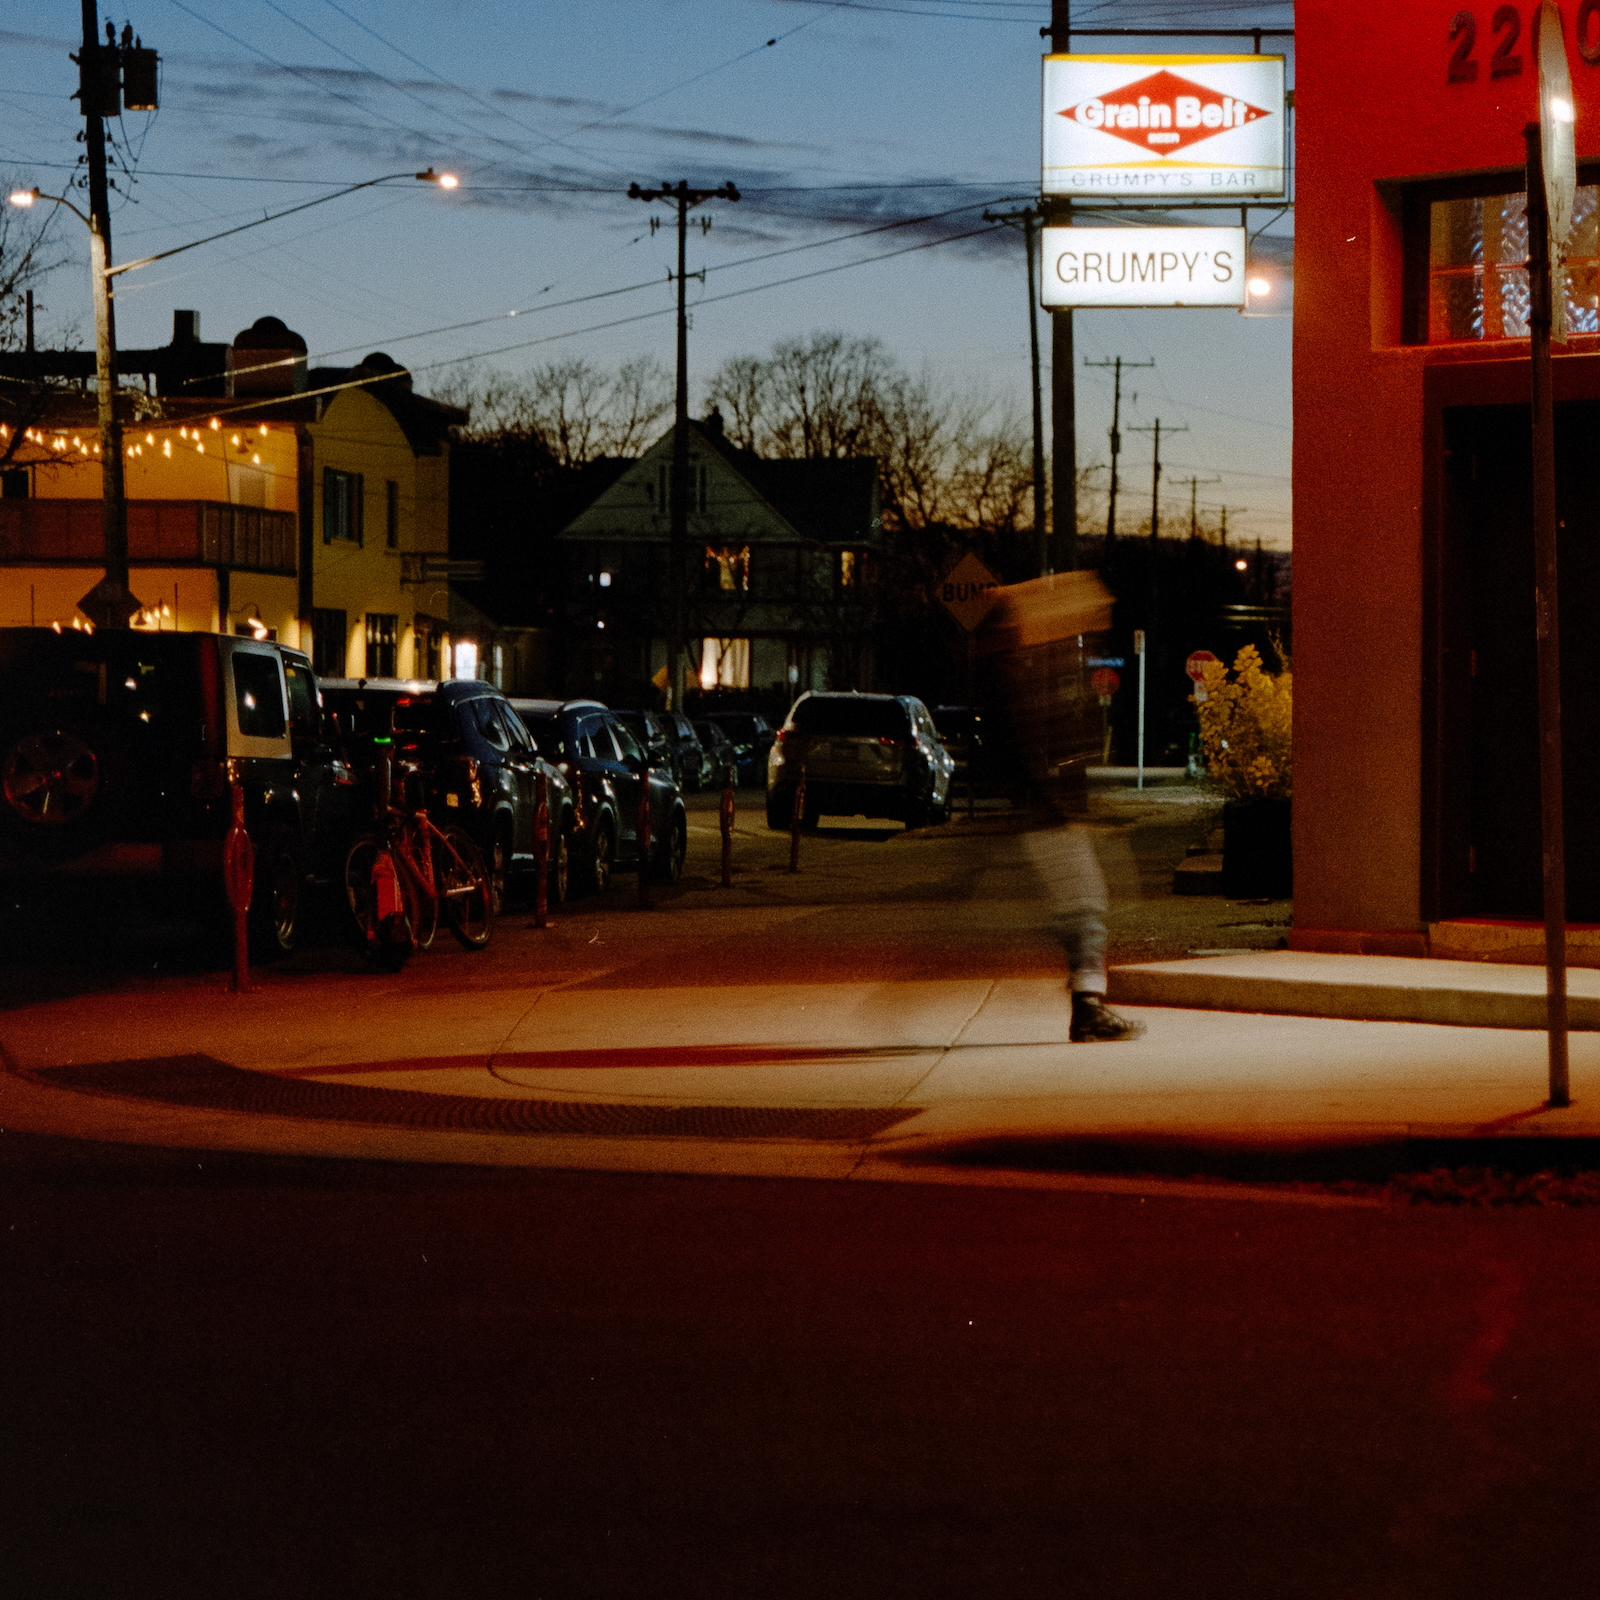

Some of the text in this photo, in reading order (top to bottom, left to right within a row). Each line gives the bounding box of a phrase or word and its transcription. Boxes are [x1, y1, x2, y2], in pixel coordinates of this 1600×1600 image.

[1075, 95, 1249, 129] Grain Belt
[1071, 172, 1257, 187] GRUMPY'S BAR
[1056, 250, 1234, 284] GRUMPY'S
